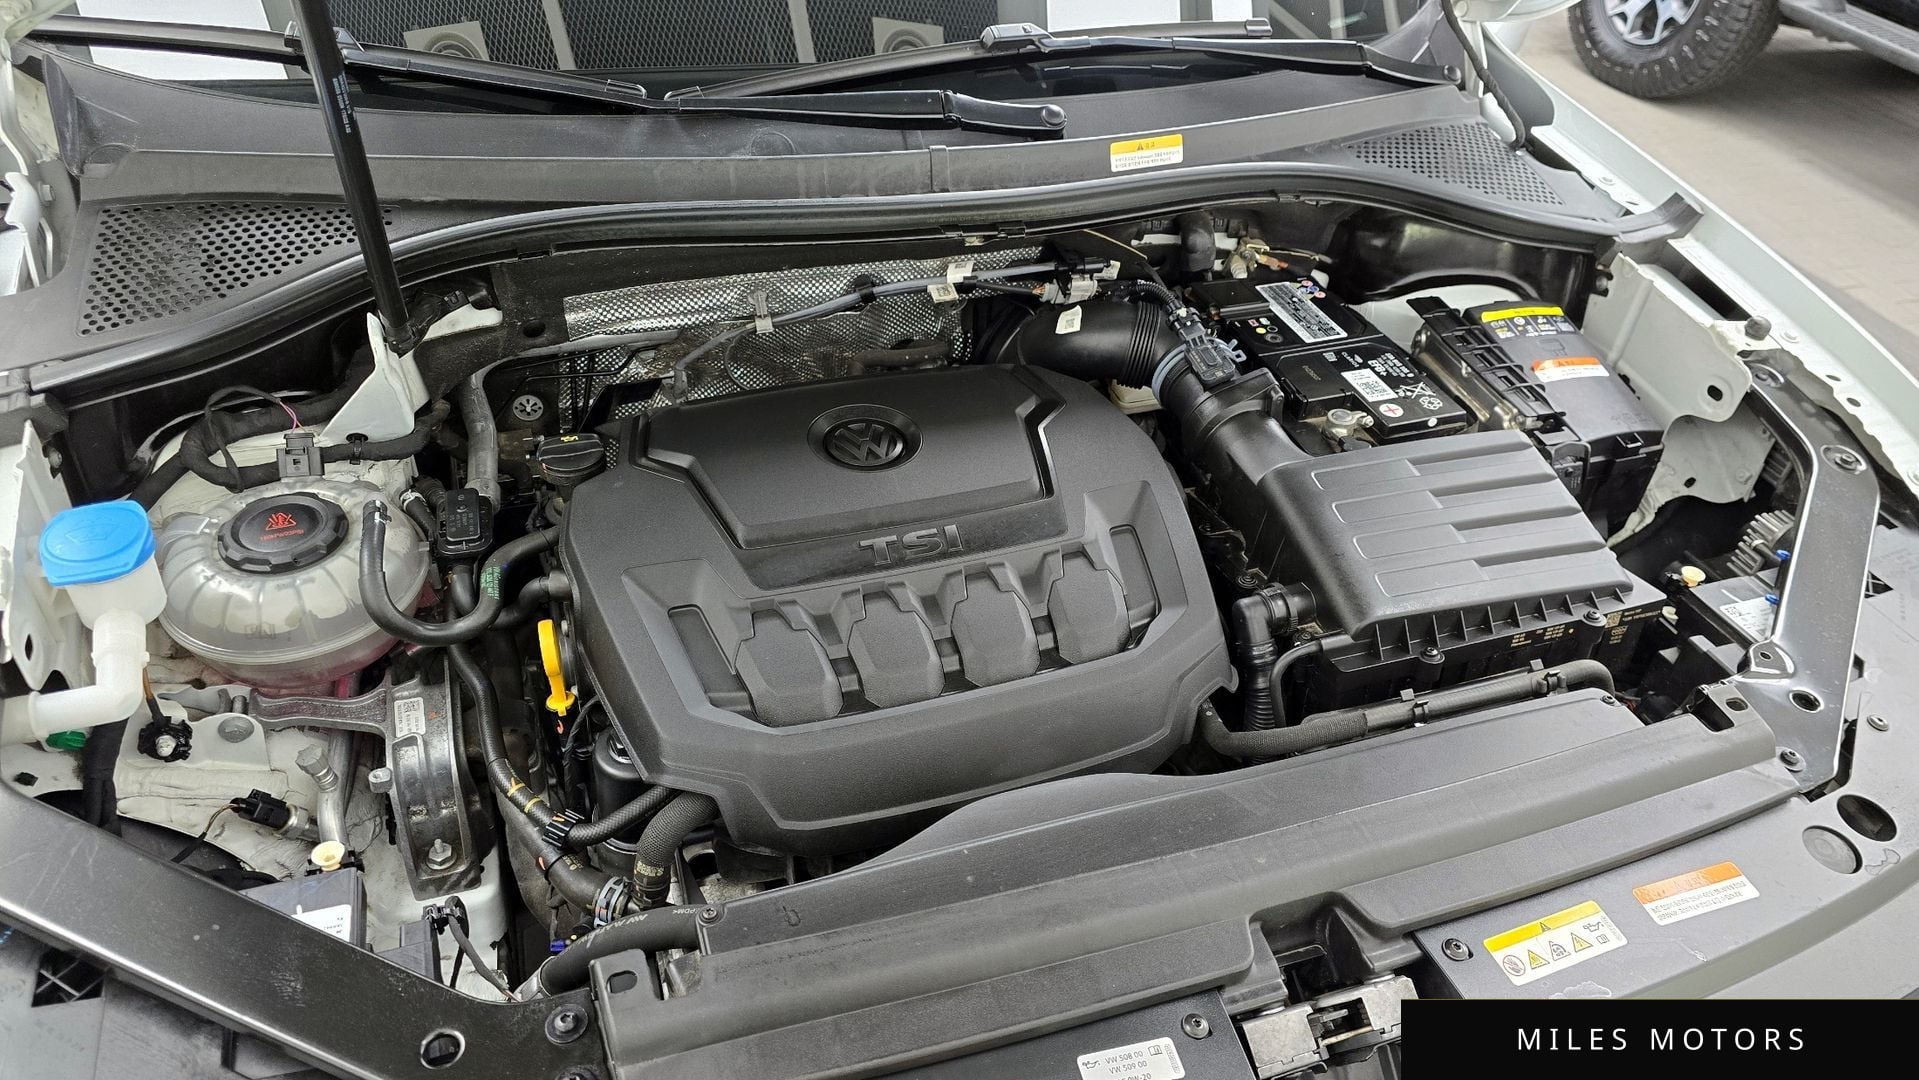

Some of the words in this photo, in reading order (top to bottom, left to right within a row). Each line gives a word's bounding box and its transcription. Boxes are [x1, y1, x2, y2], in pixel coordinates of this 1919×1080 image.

[859, 524, 964, 566] TSI
[1104, 1055, 1118, 1065] VW
[1119, 1052, 1134, 1062] 508
[1134, 1050, 1144, 1058] 00
[1108, 1065, 1121, 1075] VW
[1122, 1062, 1137, 1072] 509
[1138, 1060, 1148, 1068] 00
